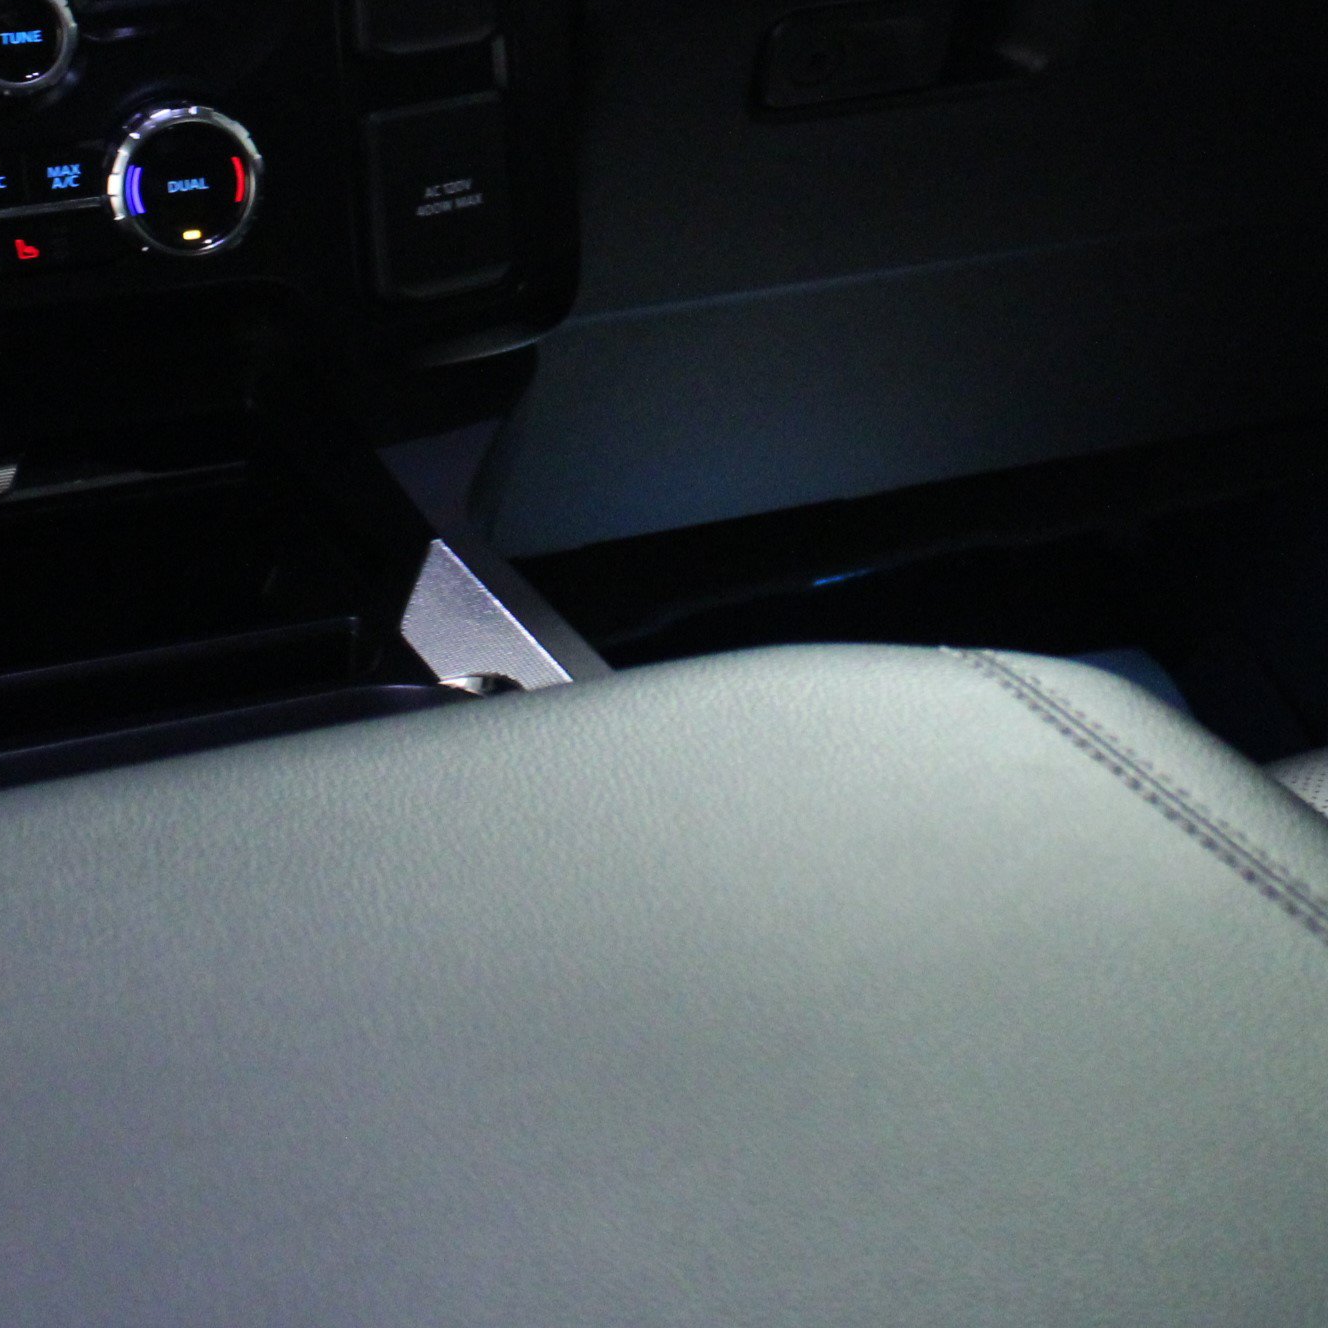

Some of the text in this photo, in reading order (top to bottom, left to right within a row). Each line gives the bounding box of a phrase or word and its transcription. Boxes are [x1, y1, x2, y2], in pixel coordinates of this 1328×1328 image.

[46, 164, 81, 178] MAX
[51, 175, 80, 189] A/C
[166, 177, 209, 193] DUAL
